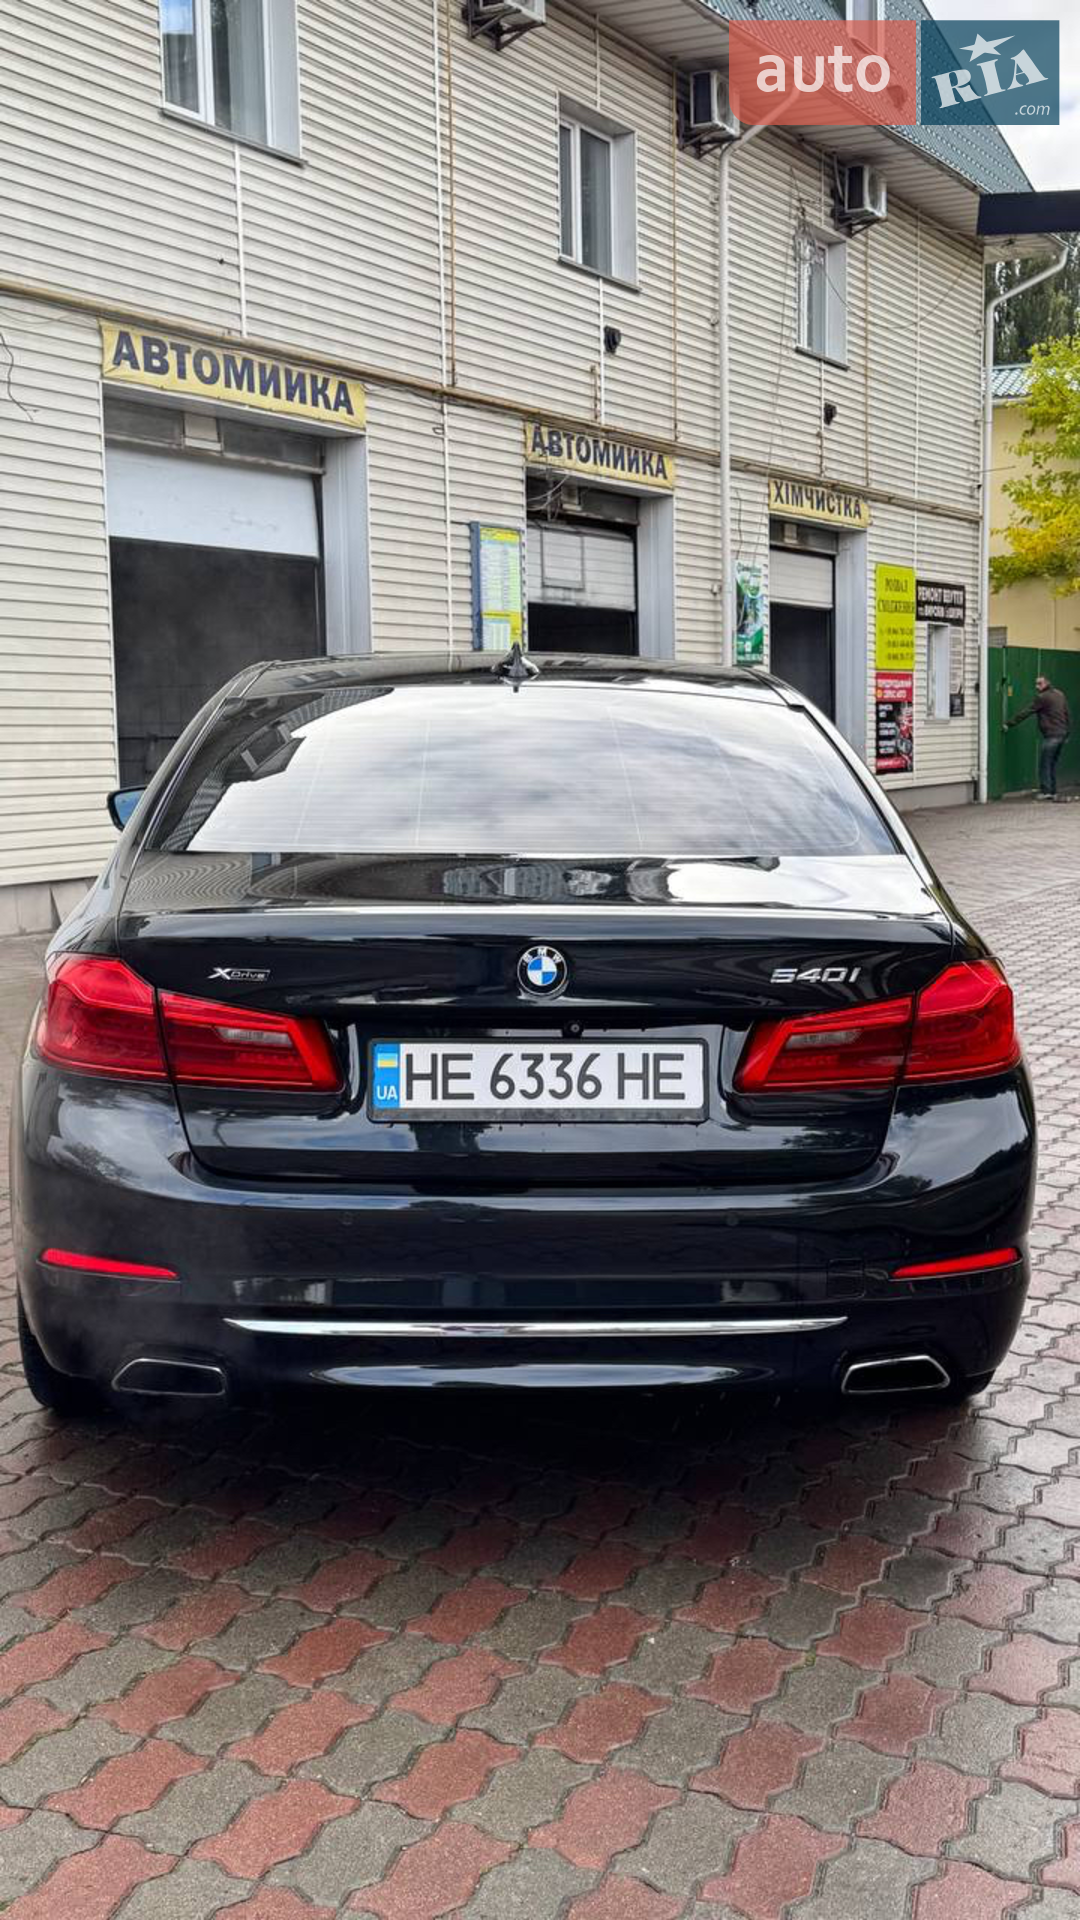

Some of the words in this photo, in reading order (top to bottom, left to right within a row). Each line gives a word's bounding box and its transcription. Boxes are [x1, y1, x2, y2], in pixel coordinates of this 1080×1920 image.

[773, 480, 863, 519] ХІМЧИСТКА
[377, 1086, 398, 1100] UA
[490, 1053, 602, 1100] 6336
